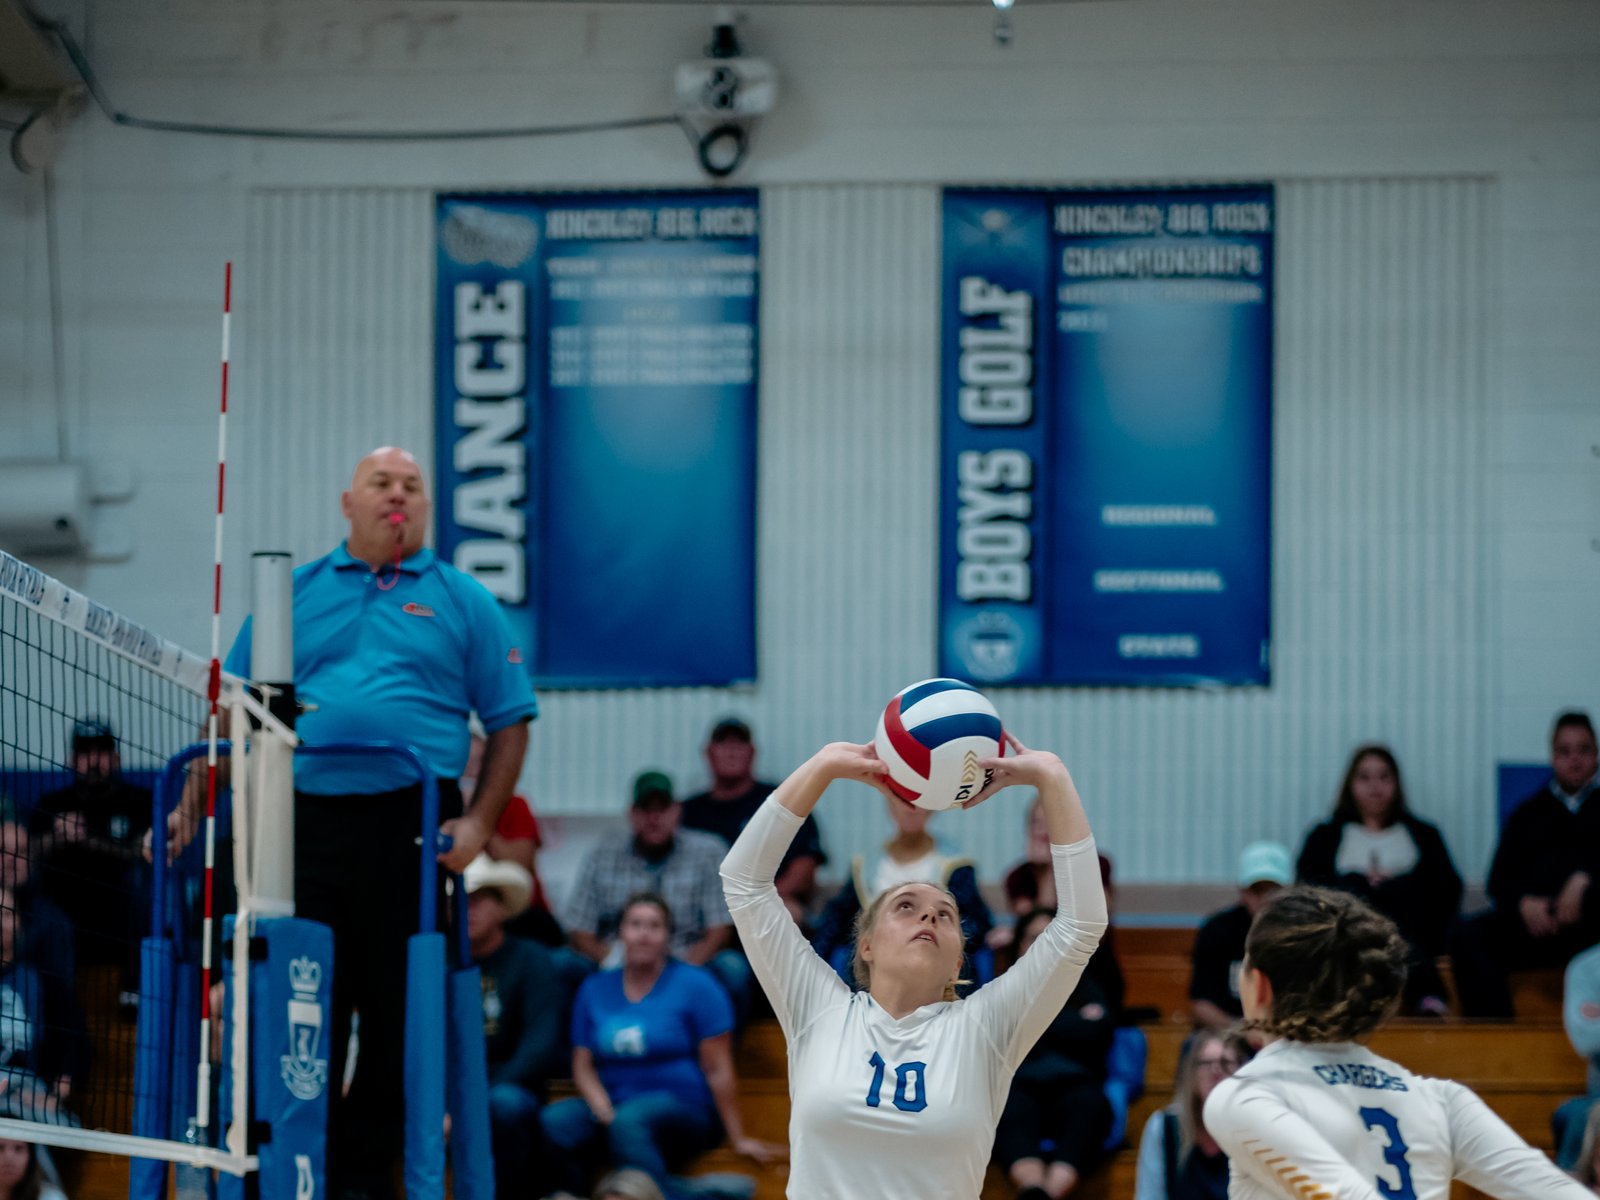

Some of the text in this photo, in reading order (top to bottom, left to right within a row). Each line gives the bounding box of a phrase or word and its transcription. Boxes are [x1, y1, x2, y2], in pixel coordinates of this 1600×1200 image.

[454, 280, 525, 604] DANCE
[957, 276, 1032, 602] BOYS GOLF
[866, 1051, 928, 1112] 10
[1313, 1063, 1409, 1092] CHARGERS
